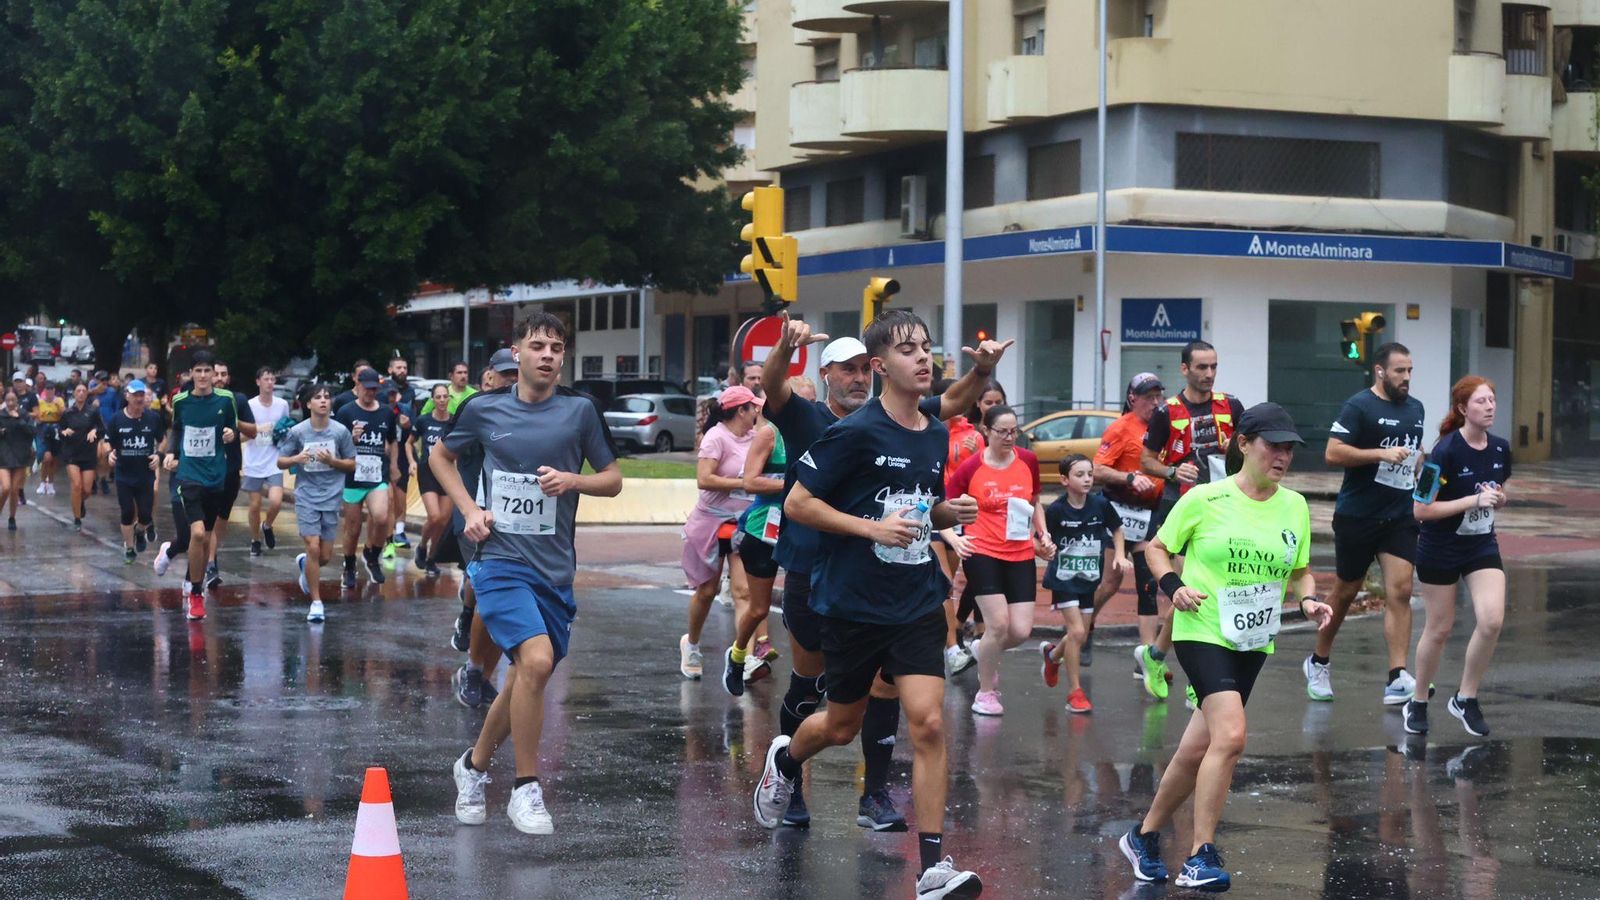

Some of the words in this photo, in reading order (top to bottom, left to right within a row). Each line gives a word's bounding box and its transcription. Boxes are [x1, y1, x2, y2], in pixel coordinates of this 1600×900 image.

[1265, 240, 1373, 259] MonteAlminara
[1125, 328, 1198, 339] MonteAlminara
[189, 439, 211, 448] 1217
[502, 496, 544, 515] 7201
[1120, 516, 1146, 530] 378
[1228, 547, 1249, 560] YO
[1254, 550, 1275, 562] NO
[1062, 557, 1097, 570] 21976
[1233, 607, 1274, 631] 6837
